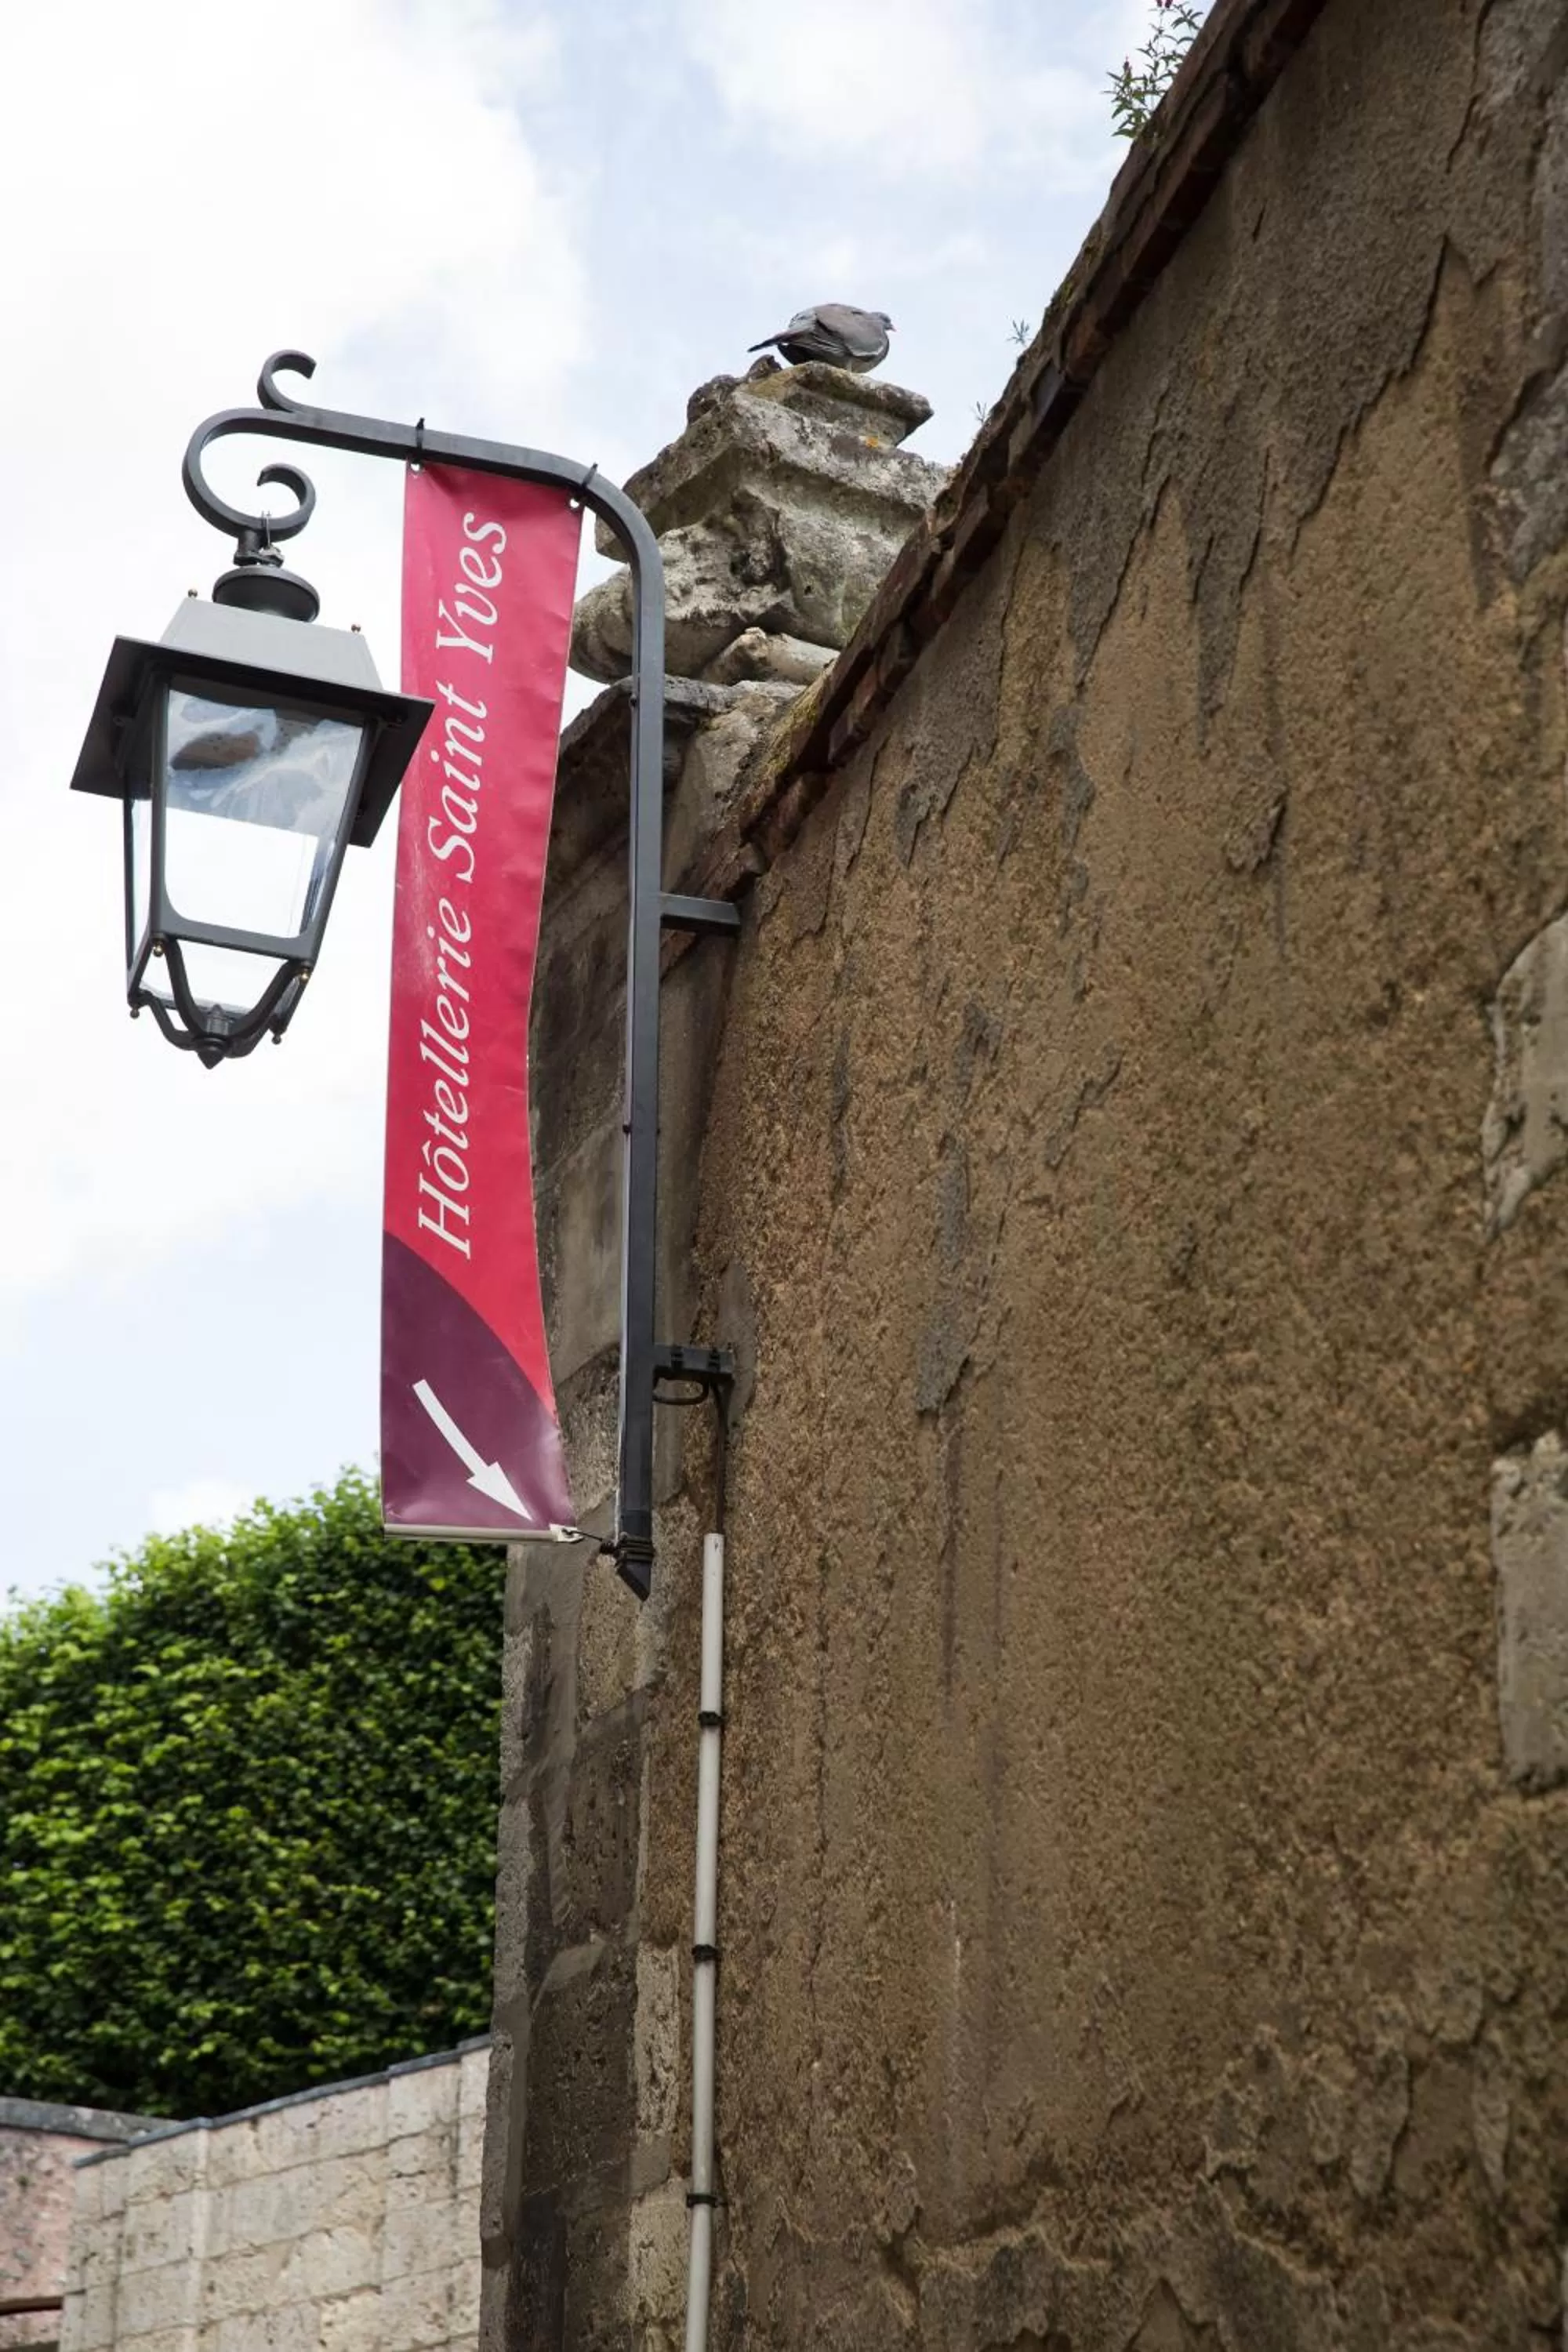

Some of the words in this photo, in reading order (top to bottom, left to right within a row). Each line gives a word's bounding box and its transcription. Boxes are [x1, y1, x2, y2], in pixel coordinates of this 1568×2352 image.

[436, 512, 507, 664] Yves
[427, 681, 488, 883] Saint
[418, 898, 471, 1259] Hôtellerie
